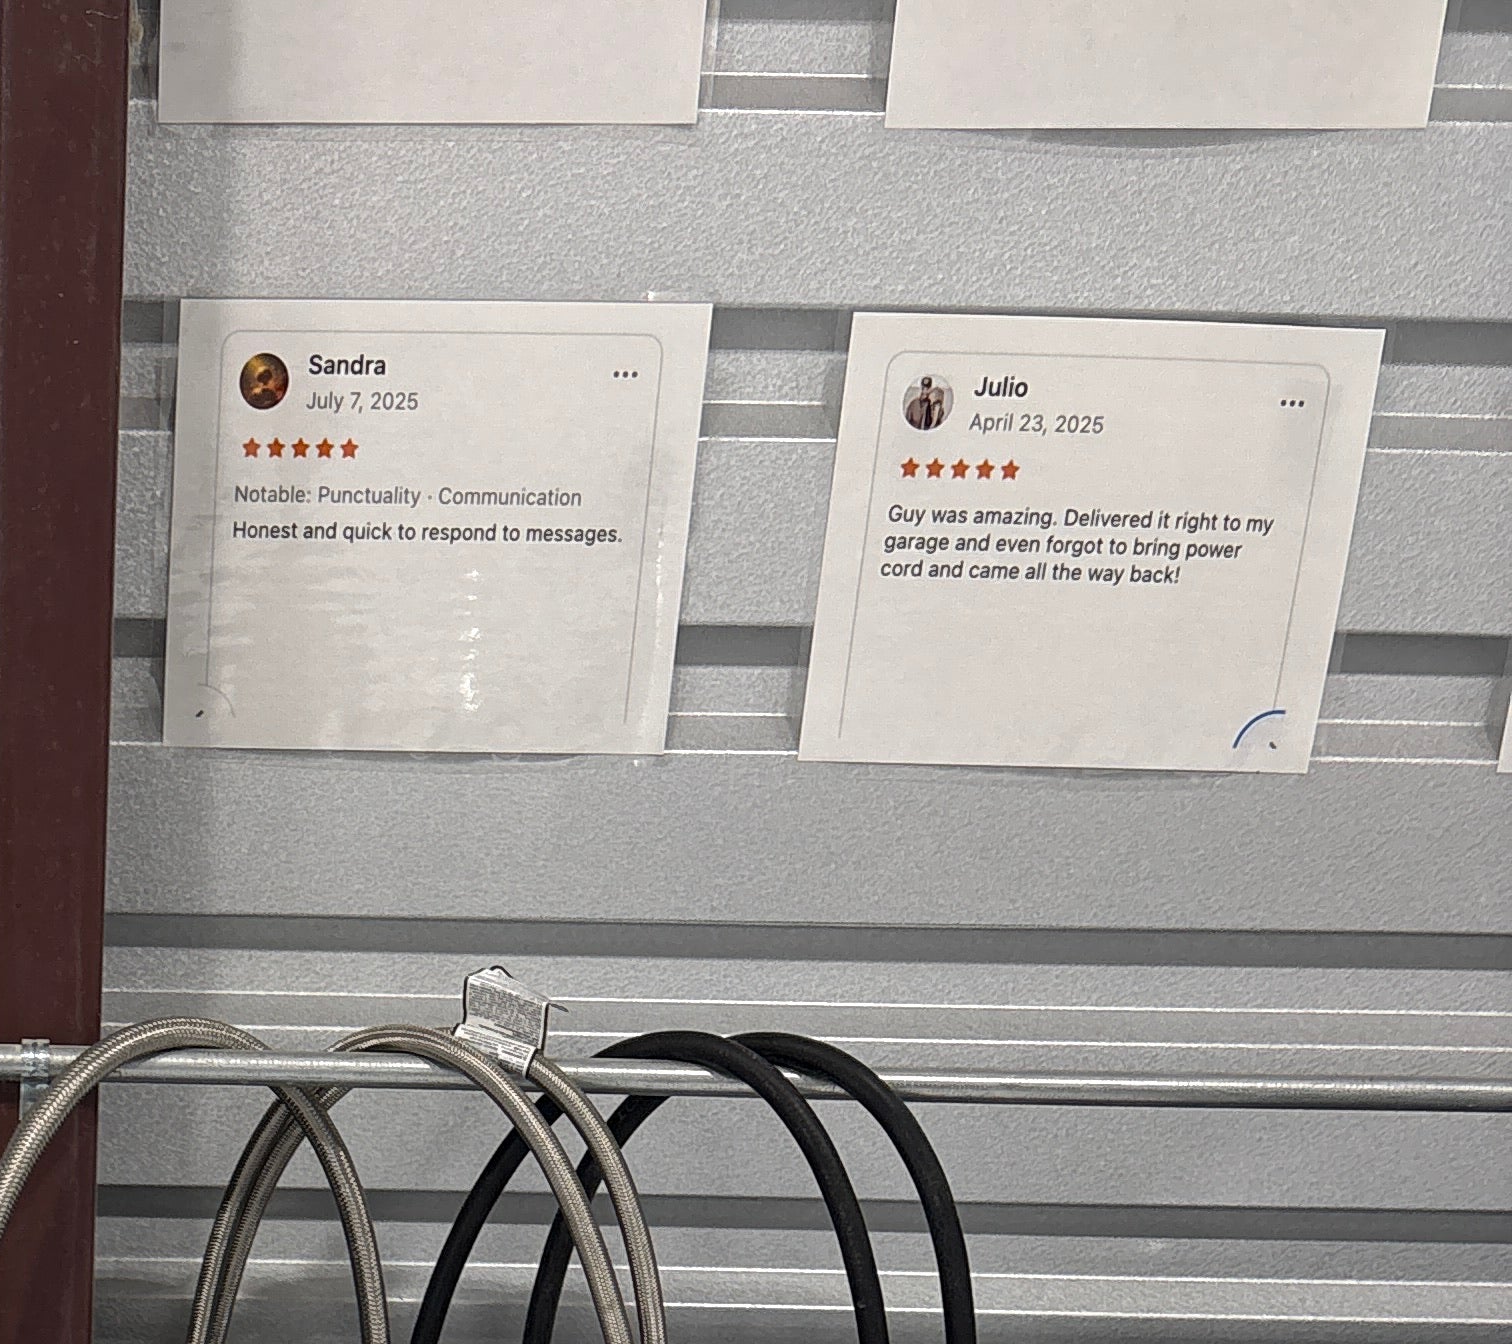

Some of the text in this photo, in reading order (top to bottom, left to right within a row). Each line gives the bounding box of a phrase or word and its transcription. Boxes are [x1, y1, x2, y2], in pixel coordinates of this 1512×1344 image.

[308, 353, 386, 376] Sandra
[973, 375, 1029, 398] Julio
[305, 390, 419, 415] July 7, 2025
[968, 412, 1105, 437] April 23, 2025
[234, 484, 582, 509] Notable: Punctuality Communication
[888, 504, 1275, 537] Guy was amazing. Delivered it right to my
[232, 520, 623, 547] Honest and quick to respond to messages.
[883, 533, 1243, 562] garage and even forgot to bring power
[880, 559, 1181, 587] cord and came all the way back!
